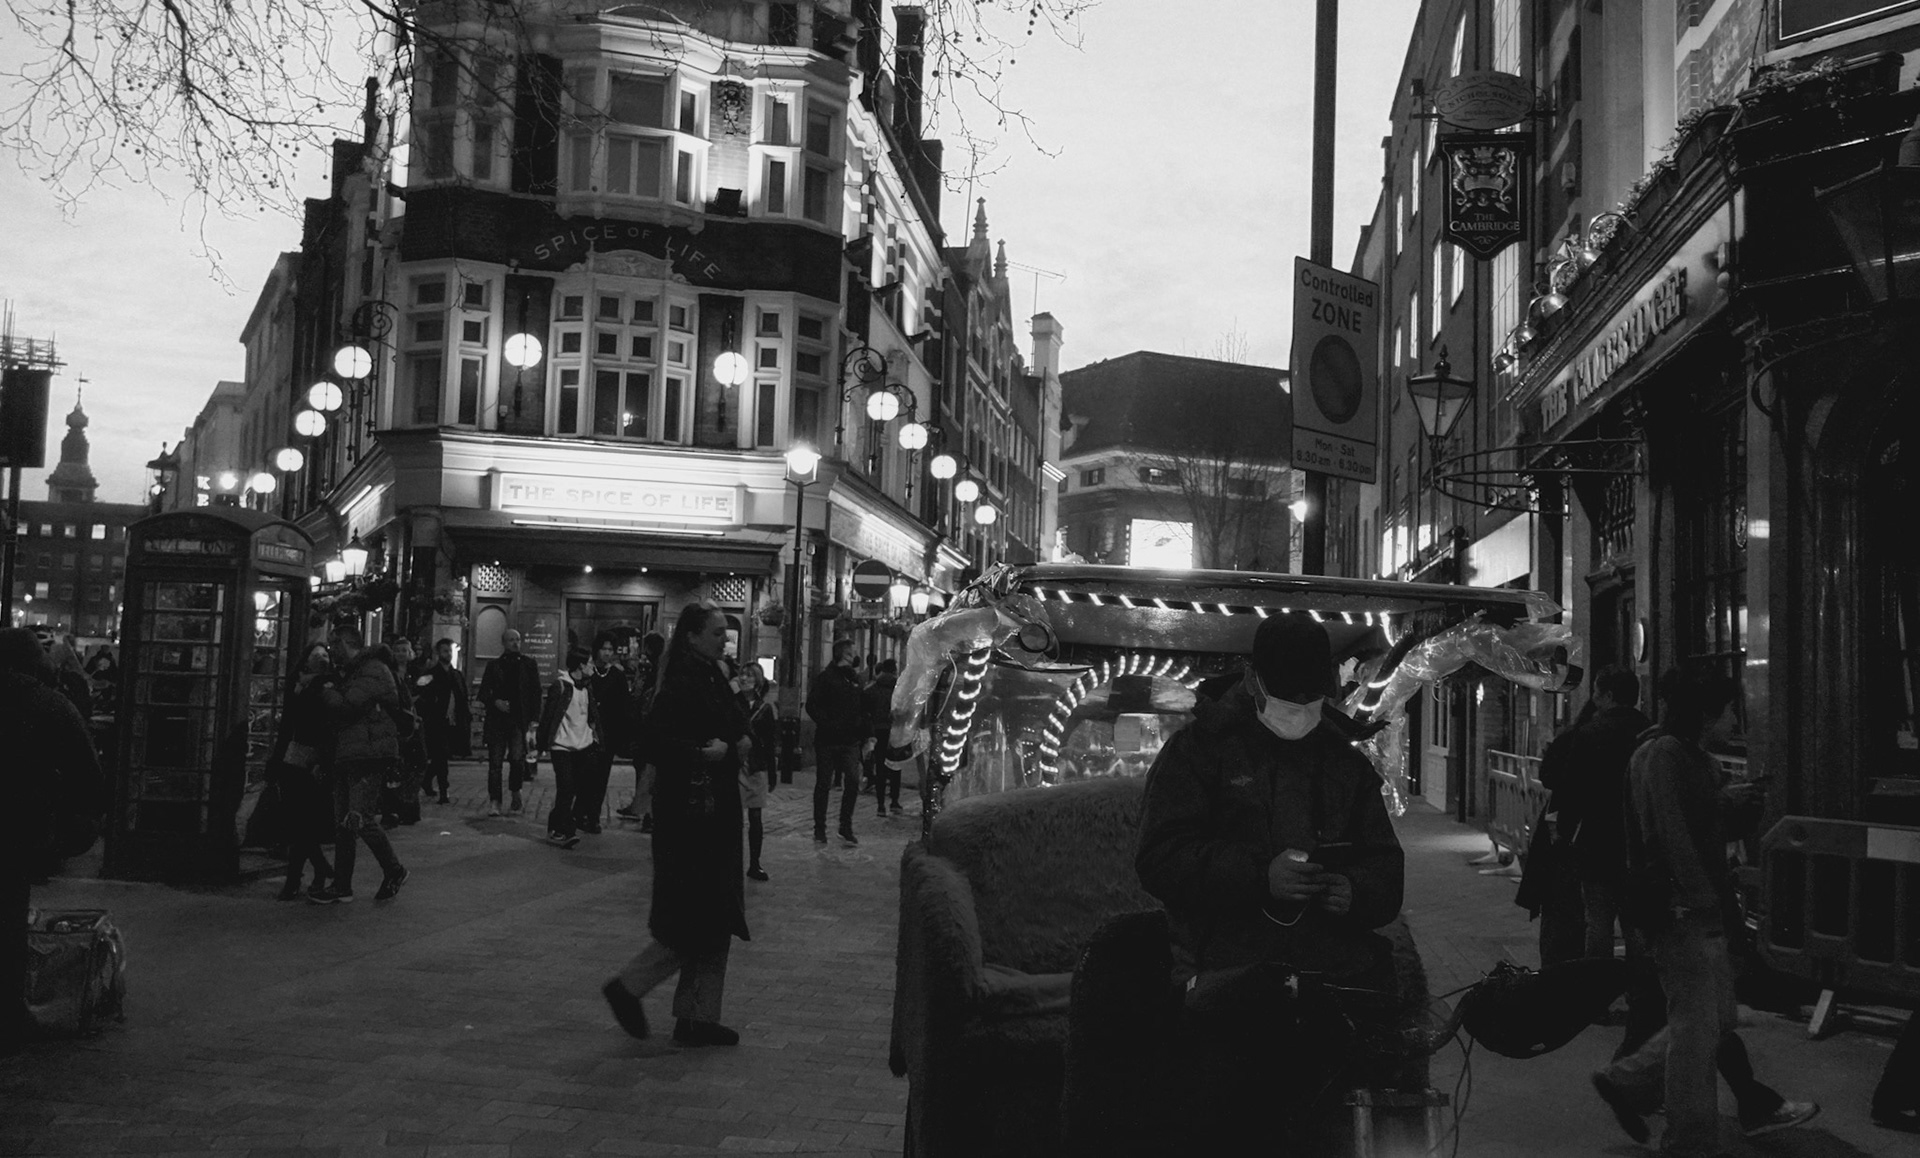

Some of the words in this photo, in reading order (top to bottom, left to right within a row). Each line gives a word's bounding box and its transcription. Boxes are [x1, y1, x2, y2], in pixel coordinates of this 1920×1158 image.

[1449, 220, 1520, 232] CAMBRIDGE
[1474, 212, 1495, 221] THE
[534, 225, 617, 260] SPICE
[628, 227, 652, 239] OF
[665, 236, 721, 280] LIFE
[1301, 268, 1373, 308] Controlled
[1311, 298, 1361, 333] ZONE
[1573, 267, 1684, 406] CAMBRIDGE
[1315, 438, 1332, 452] Mon
[1340, 444, 1355, 457] Sat
[509, 484, 555, 500] THE
[566, 488, 633, 506] SPICE
[641, 493, 671, 507] OF
[682, 495, 728, 511] LIFE
